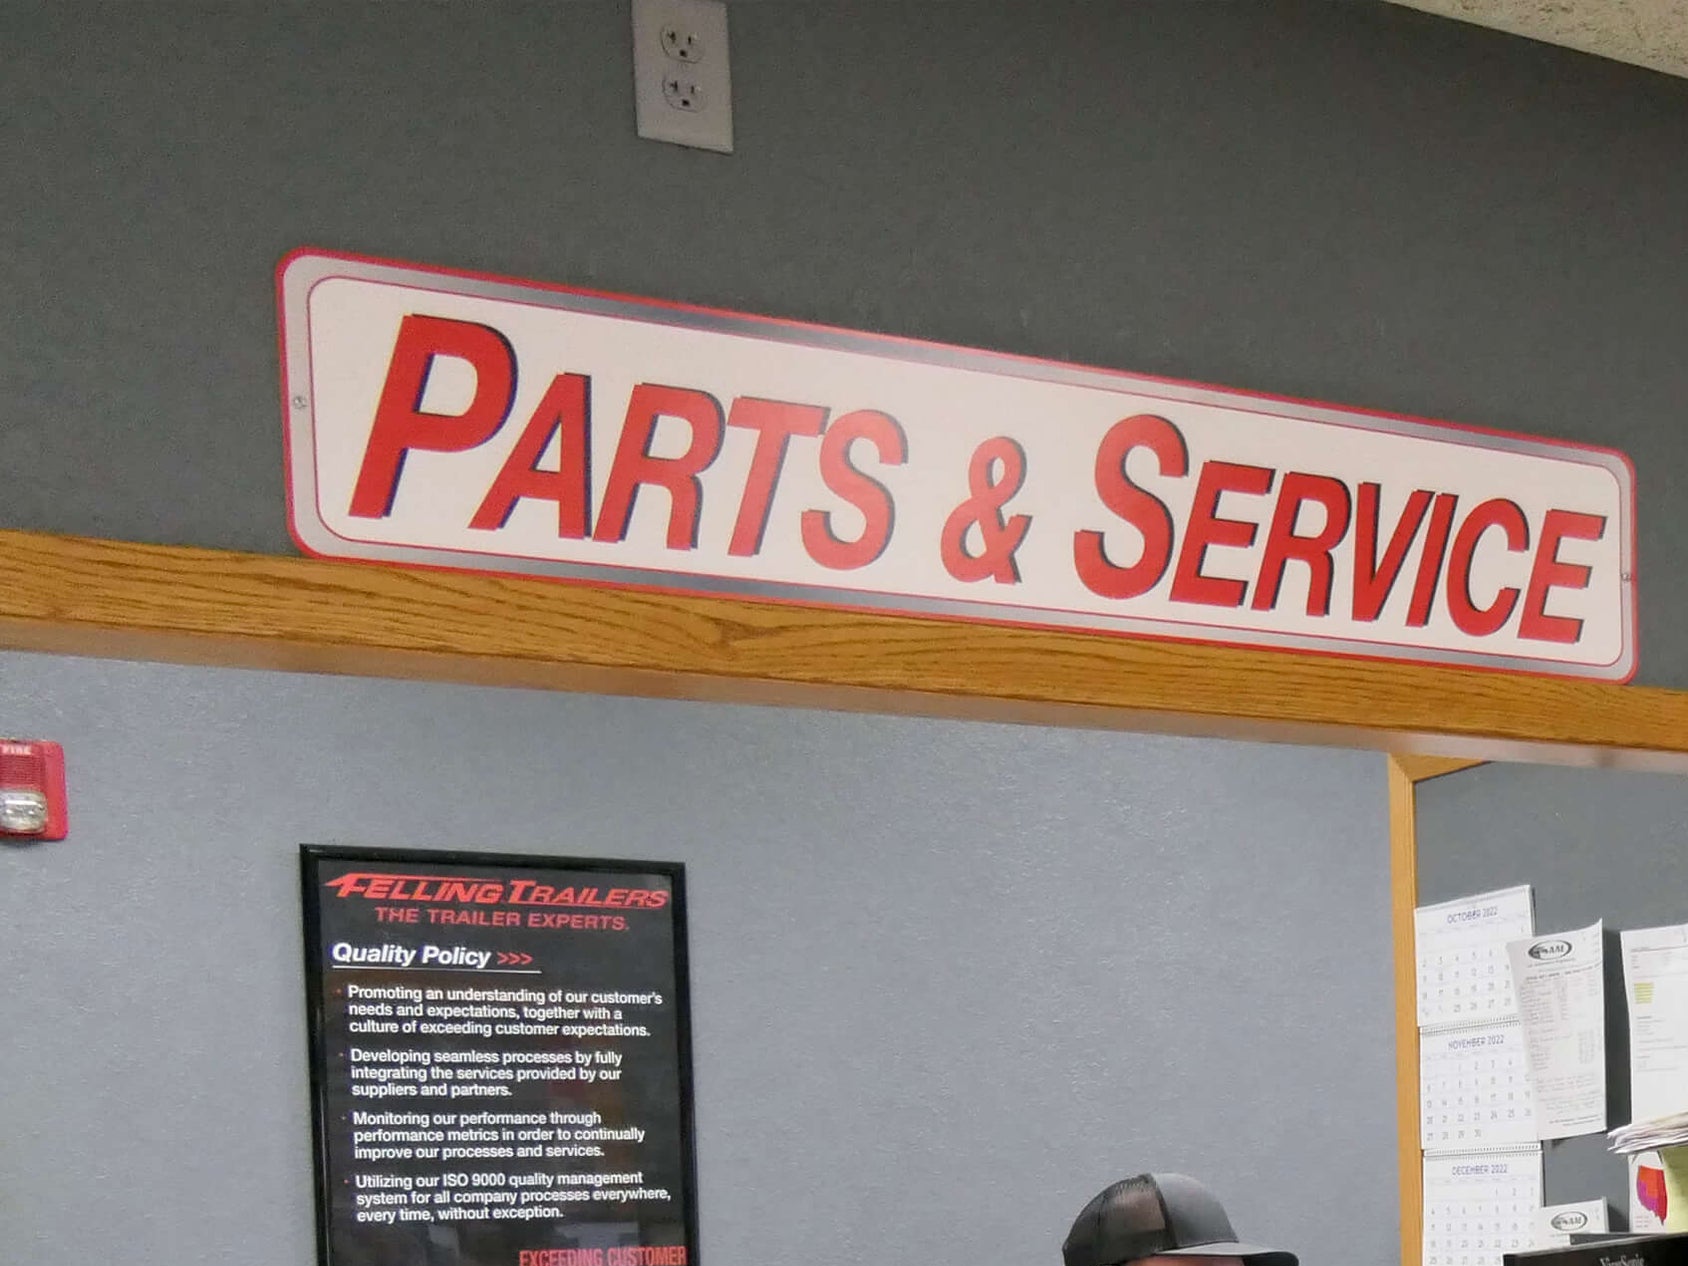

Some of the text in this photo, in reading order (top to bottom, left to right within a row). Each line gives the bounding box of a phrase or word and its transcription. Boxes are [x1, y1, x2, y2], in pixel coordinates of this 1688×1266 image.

[348, 313, 1607, 645] PARTS & SERVICE
[324, 872, 669, 909] FELLING TRAILERS
[374, 906, 419, 924] THE
[428, 908, 521, 926] TRAILER
[1447, 908, 1481, 924] OCTOBER
[332, 942, 492, 969] Quality Policy
[348, 984, 663, 1007] Promoting an understanding of our customer's
[349, 1003, 623, 1021] needs and expectations, together with a
[349, 1020, 651, 1038] culture of exceeding customer expectations.
[1448, 1034, 1505, 1050] NOVEMBER 2022
[350, 1048, 623, 1067] Developing seamless processes by fully
[350, 1066, 623, 1082] integrating the services provided by our
[351, 1083, 513, 1098] suppliers and partners.
[353, 1111, 602, 1128] Monitoring our performance through
[353, 1127, 646, 1145] performance metrics in order to continually
[354, 1144, 605, 1161] improve our processes and services.
[1451, 1165, 1489, 1176] DECEMBER
[355, 1172, 643, 1190] Utilizing our ISO 9000 quality management
[355, 1186, 672, 1207] system for all company processes everywhere,
[356, 1204, 564, 1224] every time, without exception.
